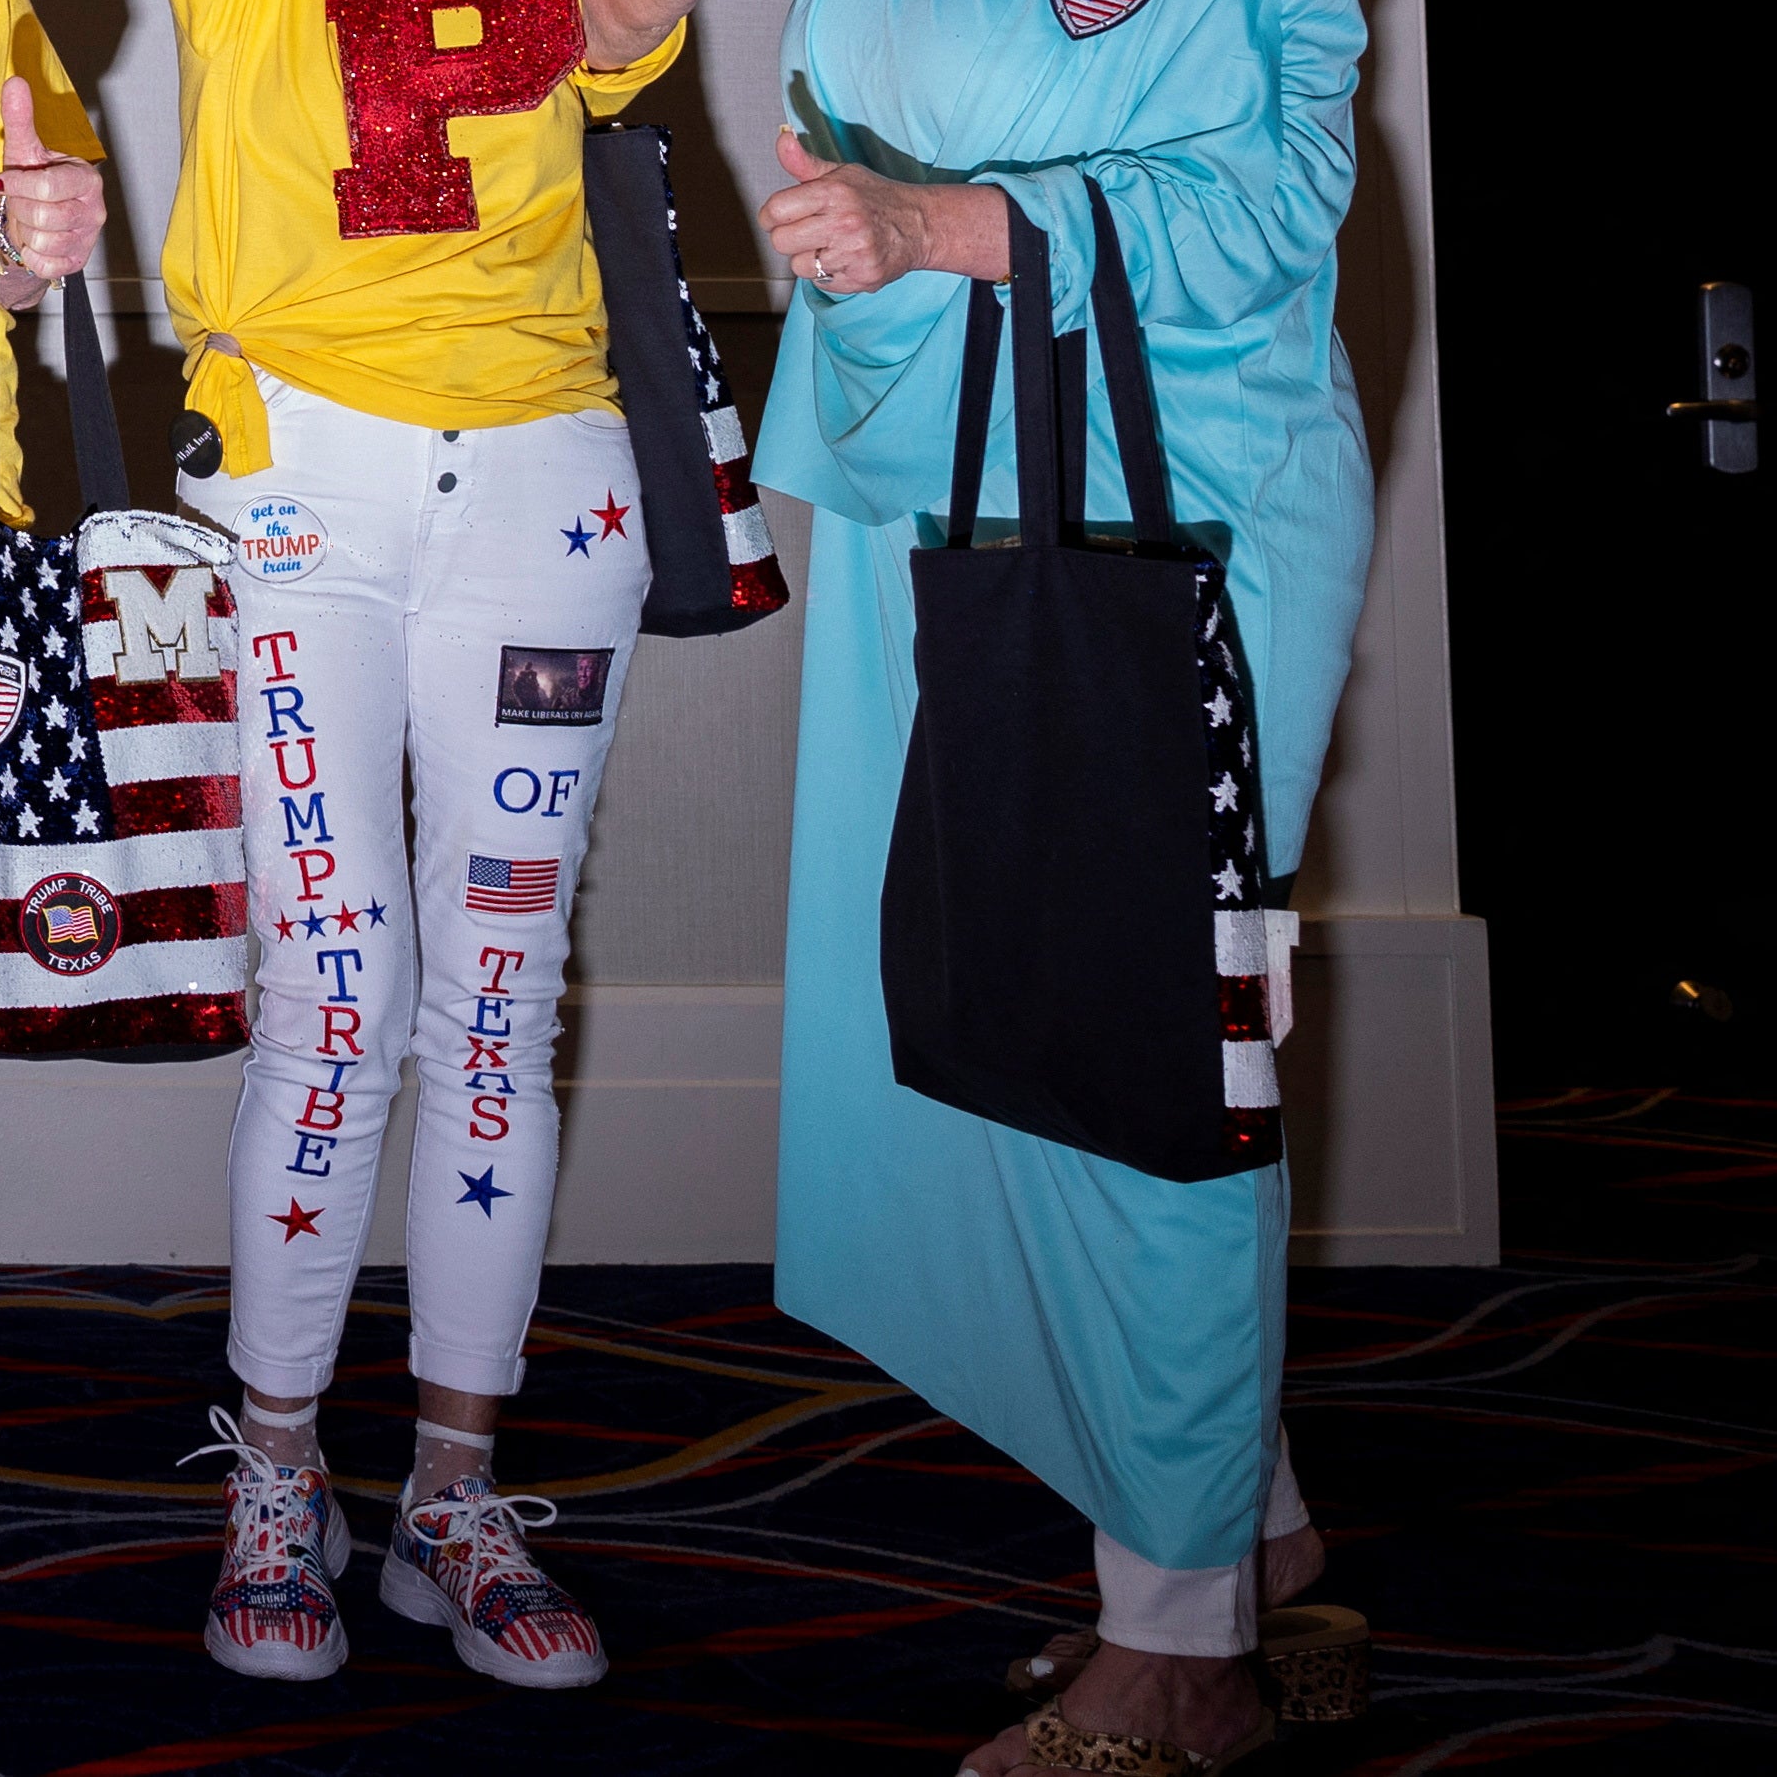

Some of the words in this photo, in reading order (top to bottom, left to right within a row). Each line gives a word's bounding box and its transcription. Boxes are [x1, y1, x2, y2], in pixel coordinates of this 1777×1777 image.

[251, 503, 277, 522] get
[279, 503, 298, 515] on
[266, 520, 289, 536] the
[242, 534, 320, 560] TRUMP
[263, 557, 302, 574] train
[103, 564, 221, 686] M
[501, 708, 529, 718] MAKE
[531, 709, 569, 719] LIBERALS
[570, 709, 583, 719] CRY
[252, 630, 336, 903] TRUMP
[493, 768, 580, 818] OF
[26, 877, 68, 915] TRUMP
[79, 878, 113, 914] TRIBE
[47, 950, 102, 971] TEXAS
[465, 946, 525, 1142] TEXAS
[285, 948, 365, 1179] TRIBE
[250, 1593, 287, 1604] DEFUND
